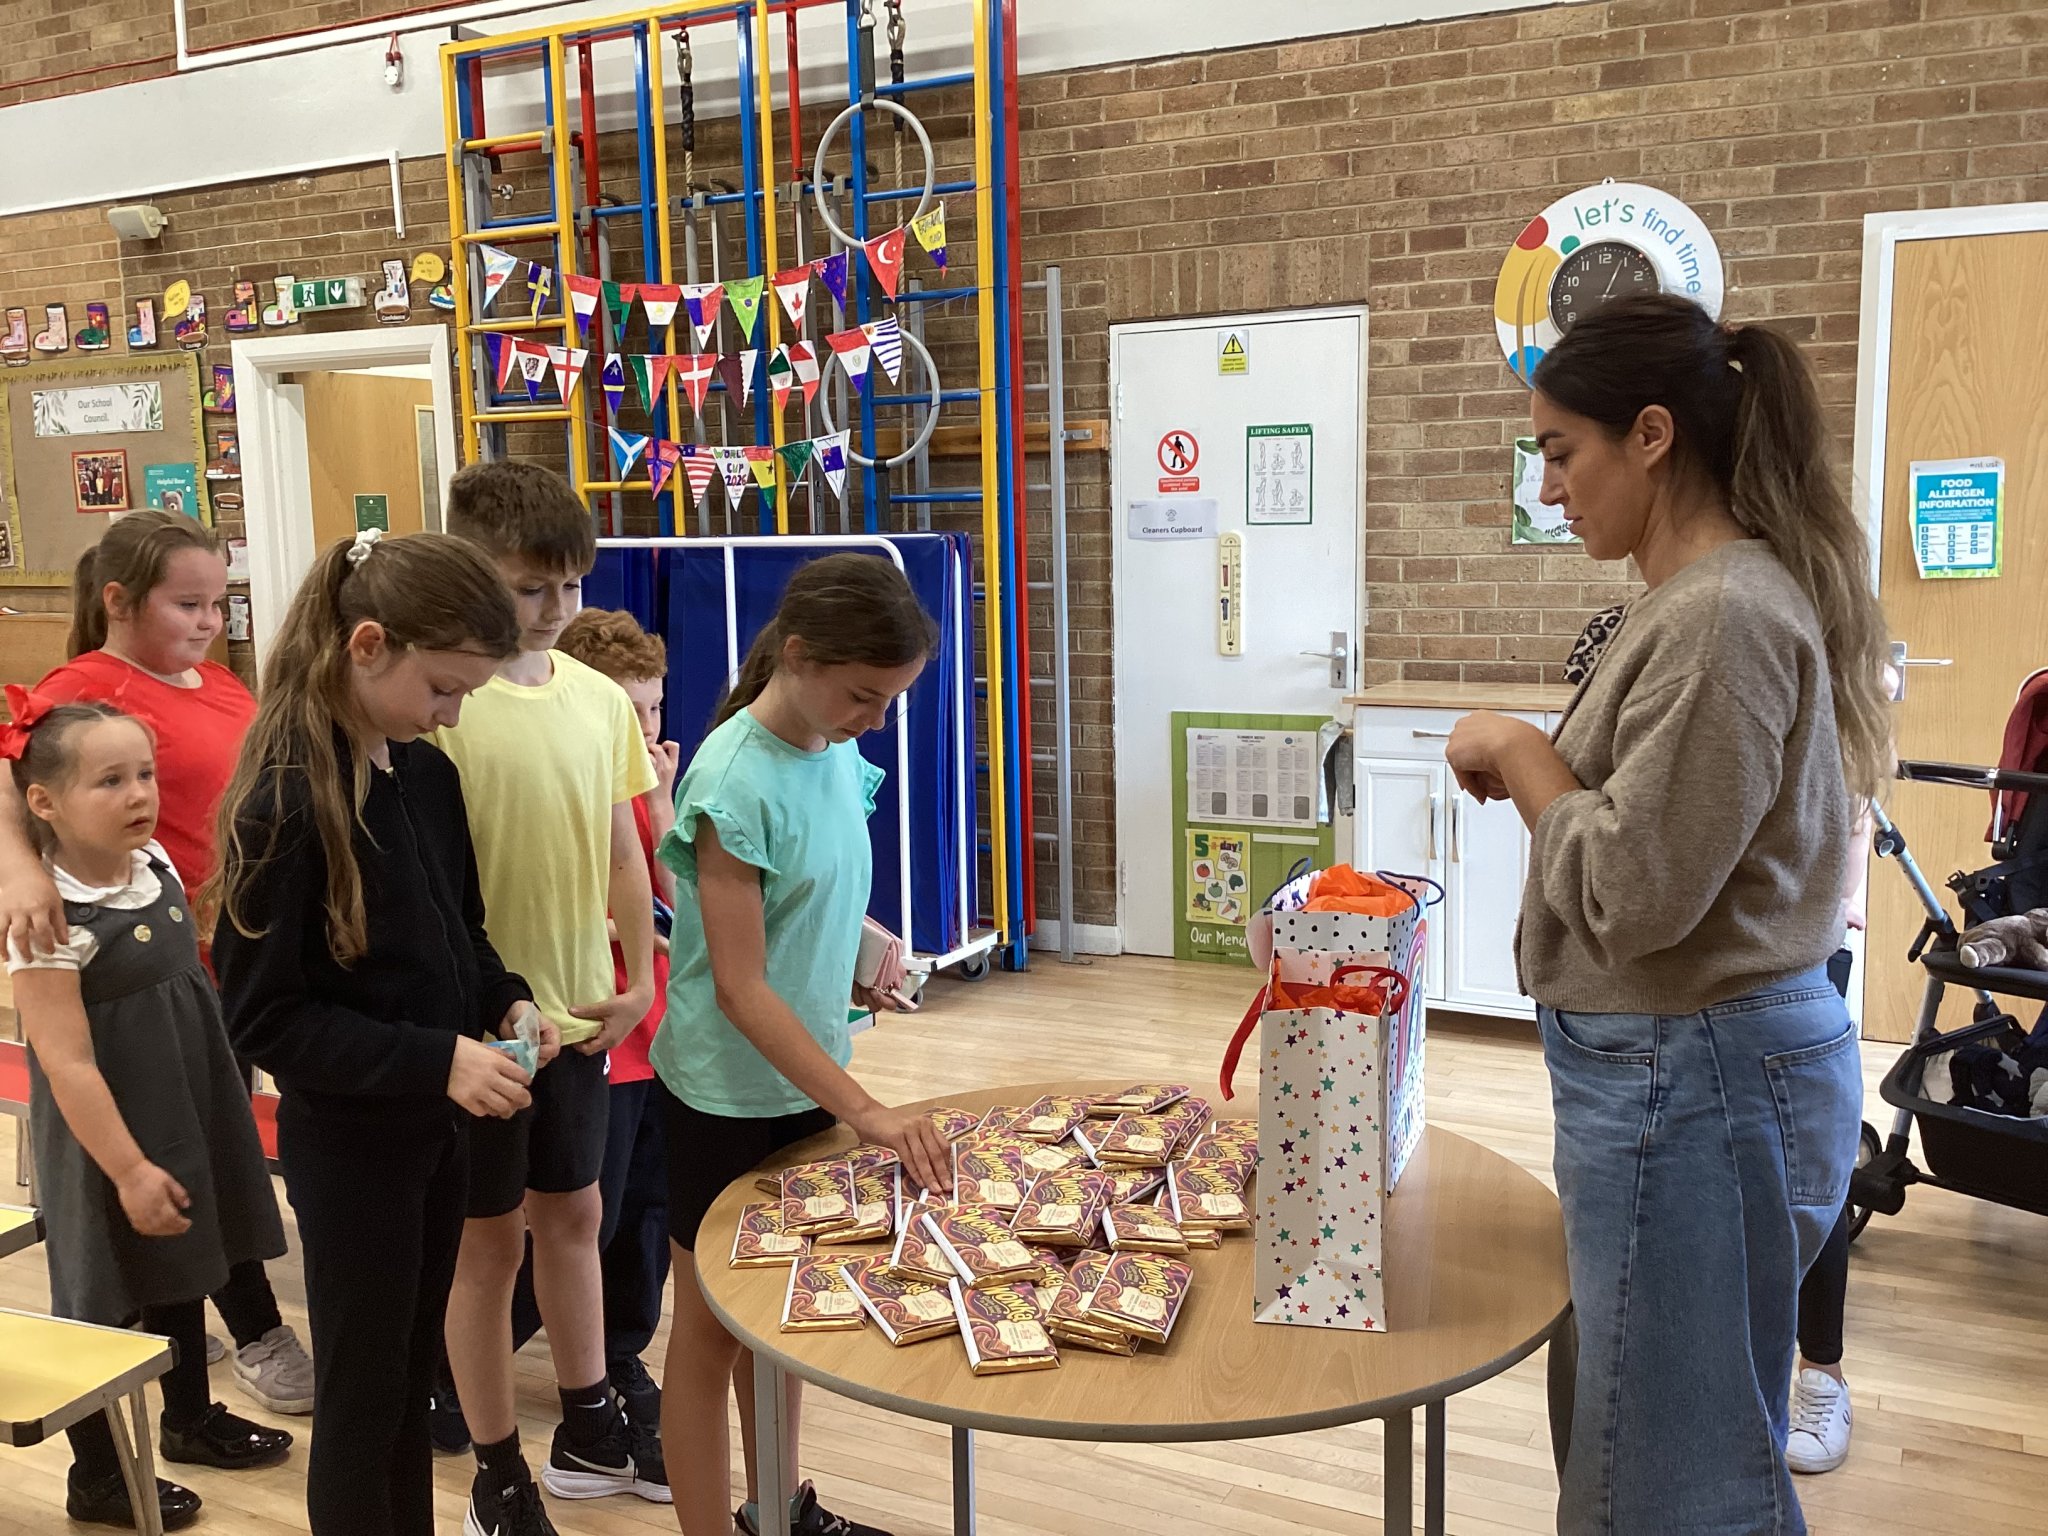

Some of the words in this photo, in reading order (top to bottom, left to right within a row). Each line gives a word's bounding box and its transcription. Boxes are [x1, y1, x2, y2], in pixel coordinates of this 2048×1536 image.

[1573, 197, 1635, 230] let's
[1642, 207, 1685, 245] find
[1676, 242, 1702, 294] time
[1598, 253, 1613, 265] 12
[1623, 257, 1628, 267] 1
[1580, 260, 1590, 271] 11
[1633, 270, 1644, 281] 2
[1567, 276, 1580, 288] 10
[1562, 294, 1572, 305] 9
[77, 400, 91, 409] Our
[91, 397, 112, 408] School
[1250, 427, 1281, 436] LIFTING
[1282, 426, 1310, 434] SAFELY
[727, 462, 744, 473] CUP
[725, 474, 747, 486] 2026
[1941, 478, 1973, 488] FOOD
[1928, 488, 1985, 499] ALLERGEN
[1918, 497, 1995, 509] INFORMATION
[1142, 526, 1169, 534] Cleaners
[1170, 526, 1203, 535] Cupboard
[1190, 926, 1212, 944] Our
[1215, 930, 1248, 948] Menu
